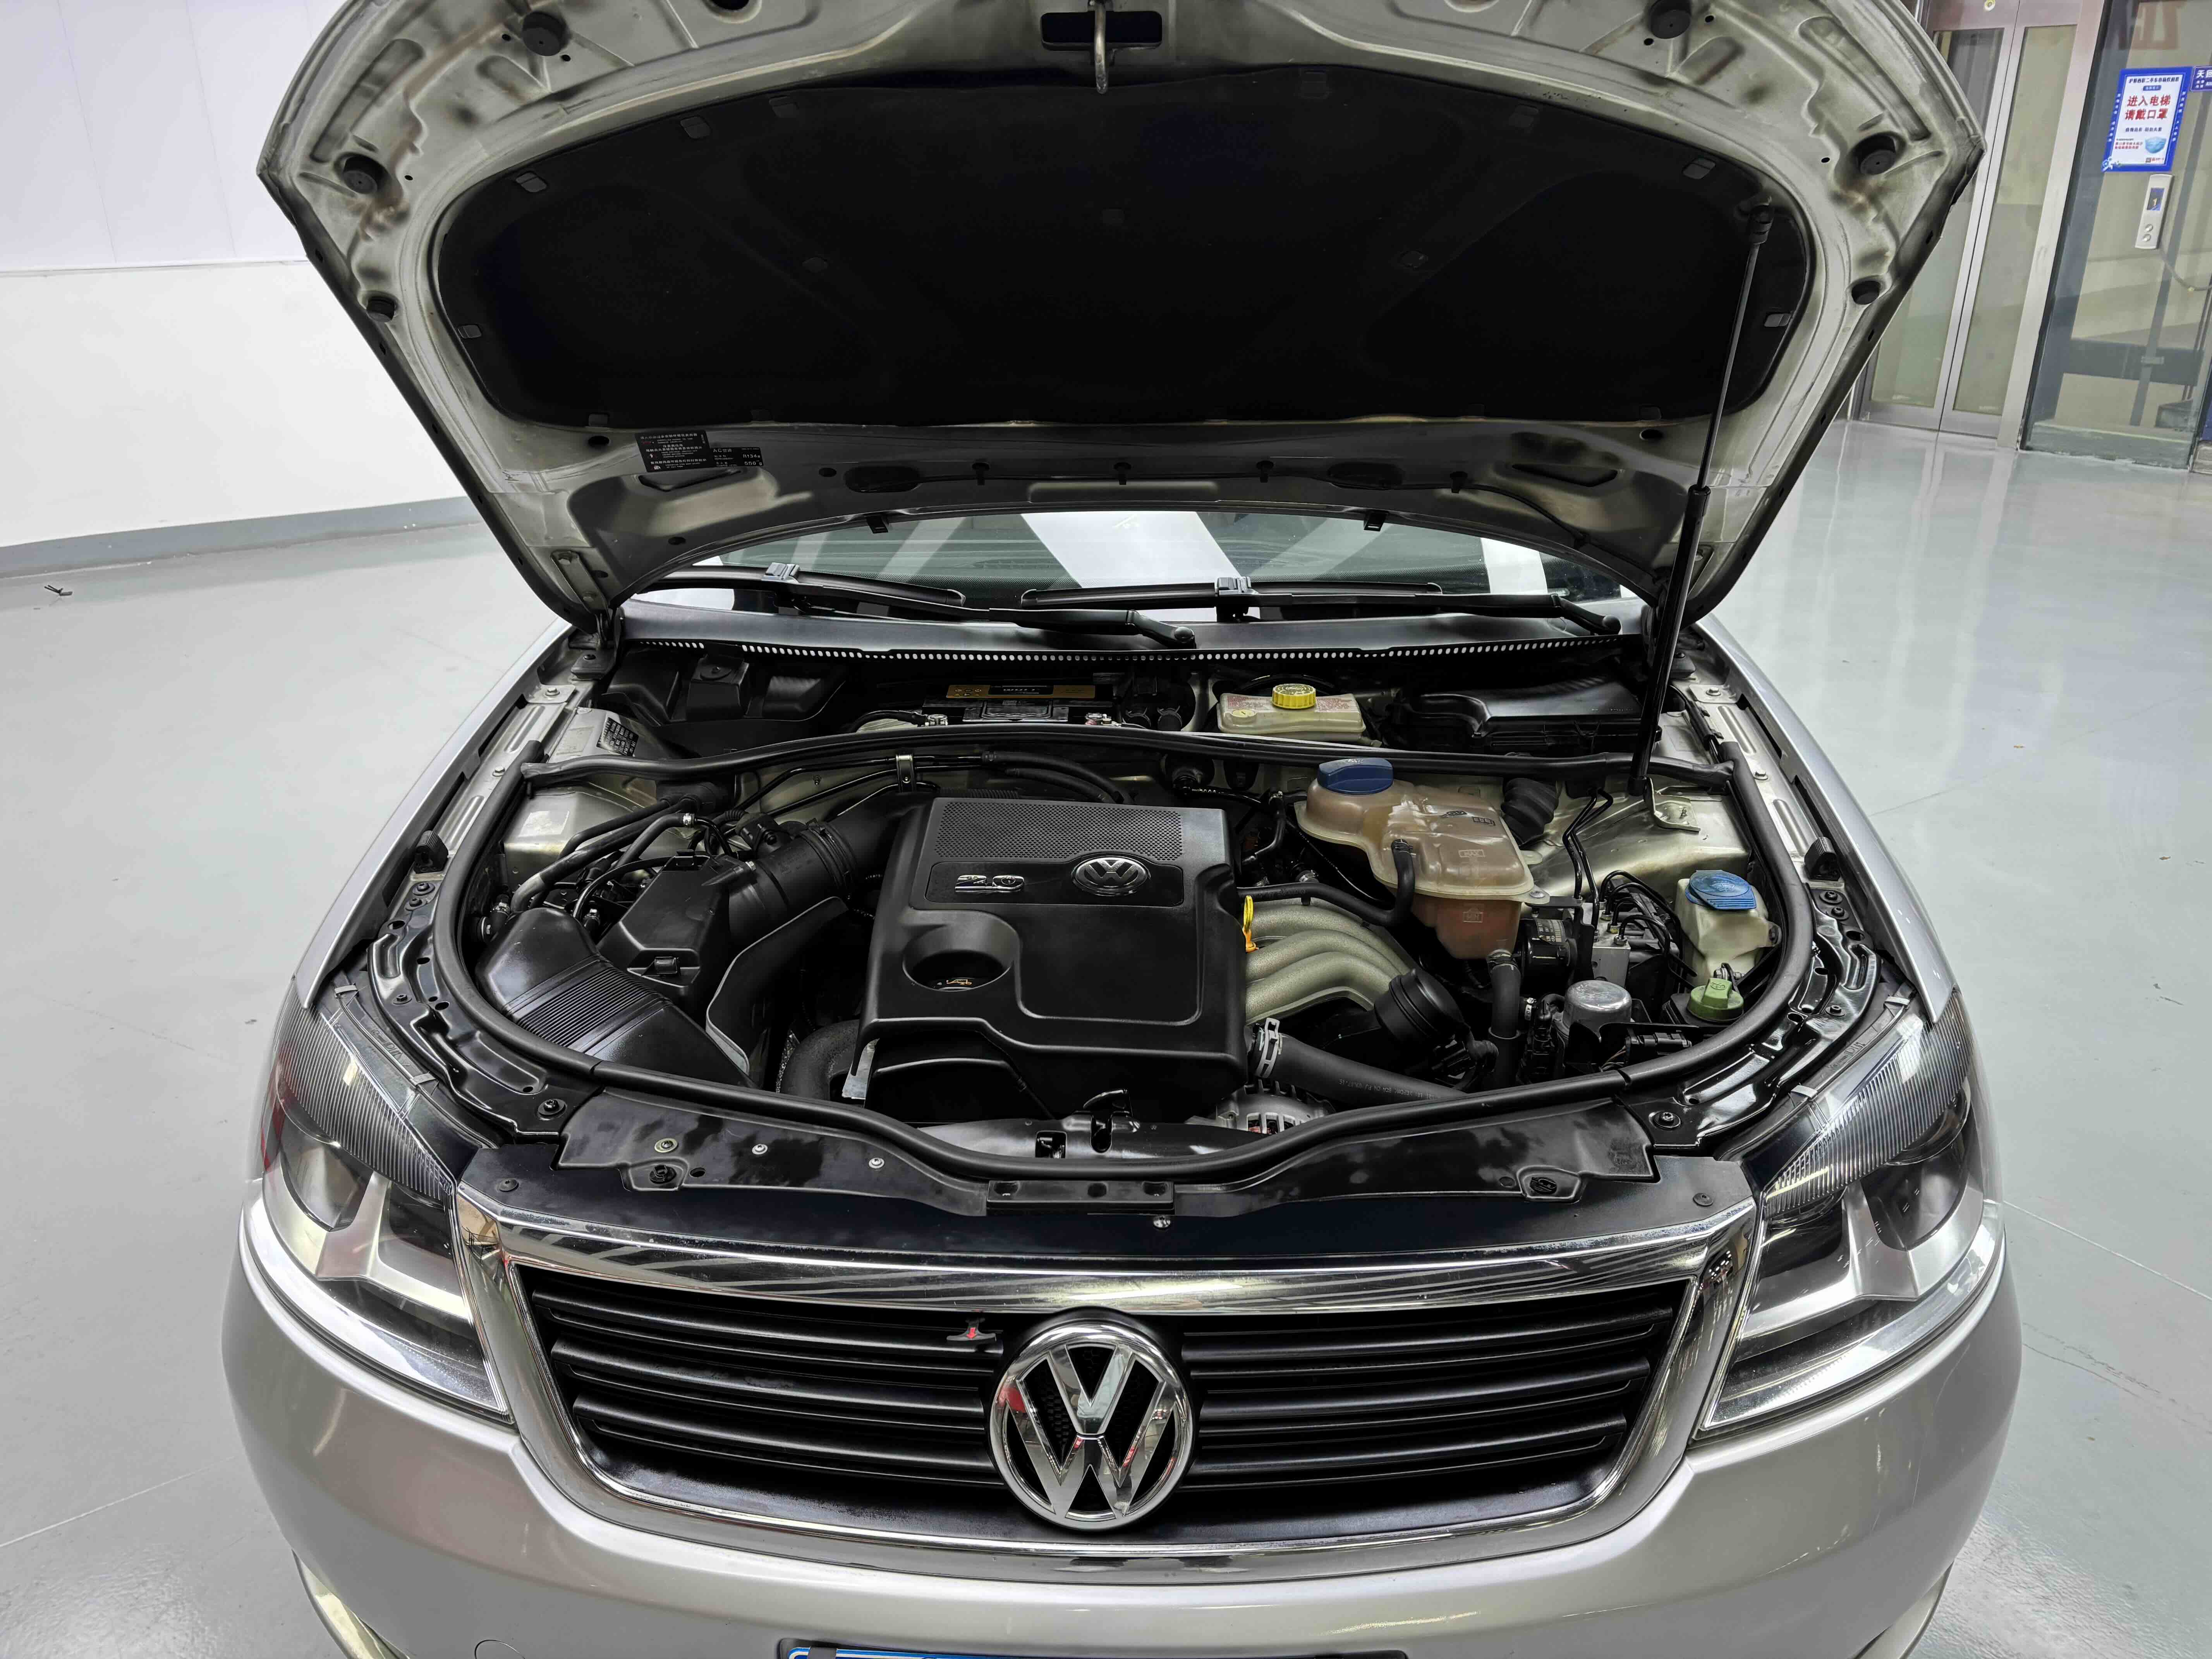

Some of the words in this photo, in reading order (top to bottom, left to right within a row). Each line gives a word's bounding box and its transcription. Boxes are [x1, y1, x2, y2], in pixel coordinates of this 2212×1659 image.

[2127, 94, 2171, 107] 进入电梯
[2125, 108, 2169, 120] 请戴口罩
